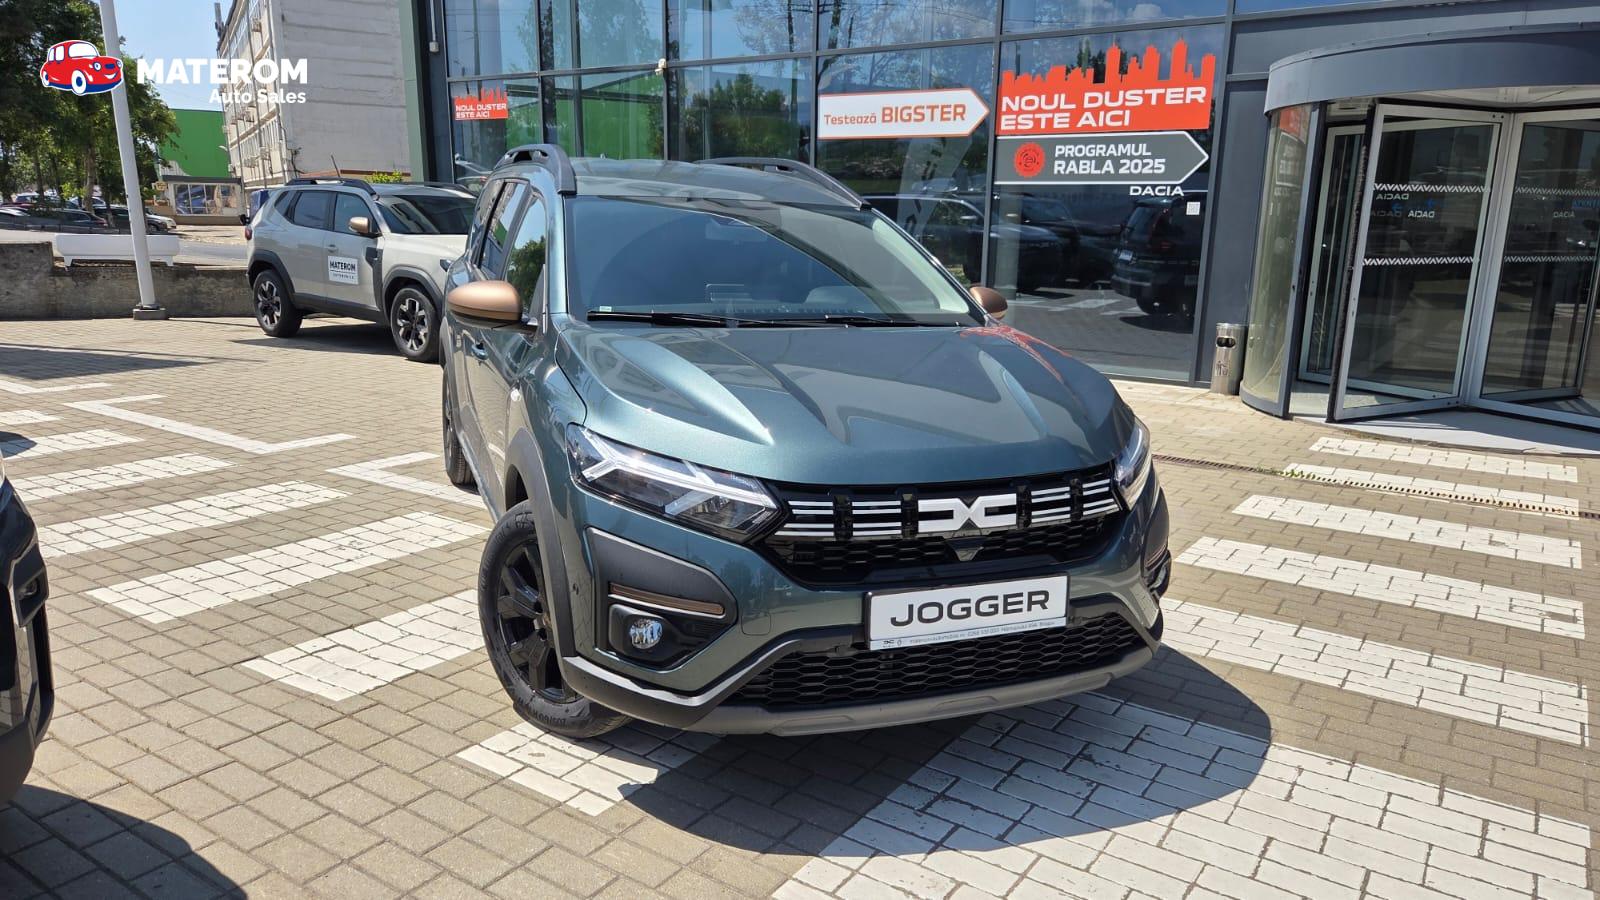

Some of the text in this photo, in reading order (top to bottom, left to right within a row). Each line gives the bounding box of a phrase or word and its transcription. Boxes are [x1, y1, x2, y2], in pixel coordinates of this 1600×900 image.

[455, 103, 507, 112] NOUL DUSTER
[1001, 86, 1206, 112] NOUL DUSTER
[456, 111, 475, 119] ESTE
[881, 104, 966, 123] BIGSTER
[1001, 110, 1130, 131] ESTE AICI
[1054, 143, 1152, 158] PROGRAMUL
[1053, 159, 1115, 175] RABLA
[1118, 158, 1166, 174] 2025
[1129, 185, 1185, 197] DACIA
[890, 590, 1050, 627] JOGGER
